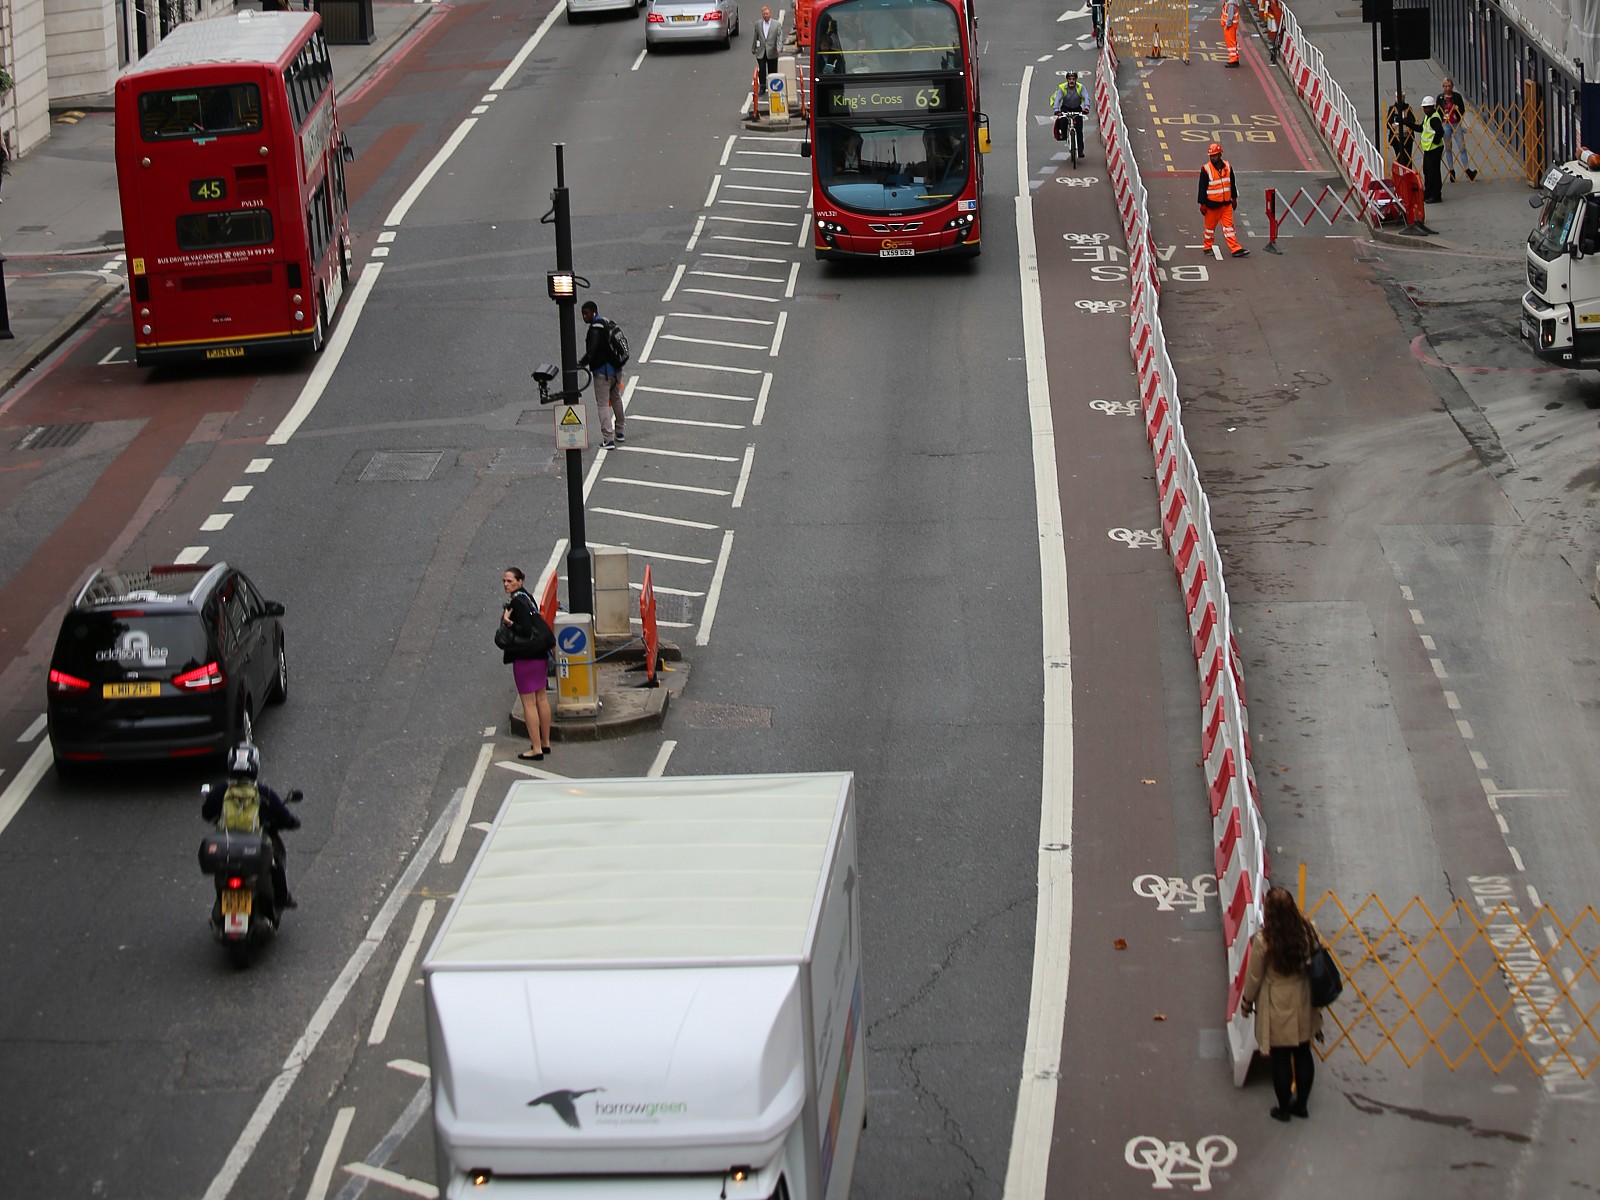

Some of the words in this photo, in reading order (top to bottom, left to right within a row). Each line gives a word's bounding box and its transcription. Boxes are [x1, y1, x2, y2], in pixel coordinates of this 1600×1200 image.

[833, 94, 866, 109] King's
[871, 93, 902, 105] Cross
[915, 88, 940, 108] 63
[1161, 113, 1281, 126] STOP
[1180, 130, 1276, 143] BUS
[197, 181, 221, 199] 45
[95, 645, 141, 661] addison
[150, 645, 169, 659] lee
[1467, 875, 1522, 915] SOLO
[595, 1100, 687, 1118] harrowgreen
